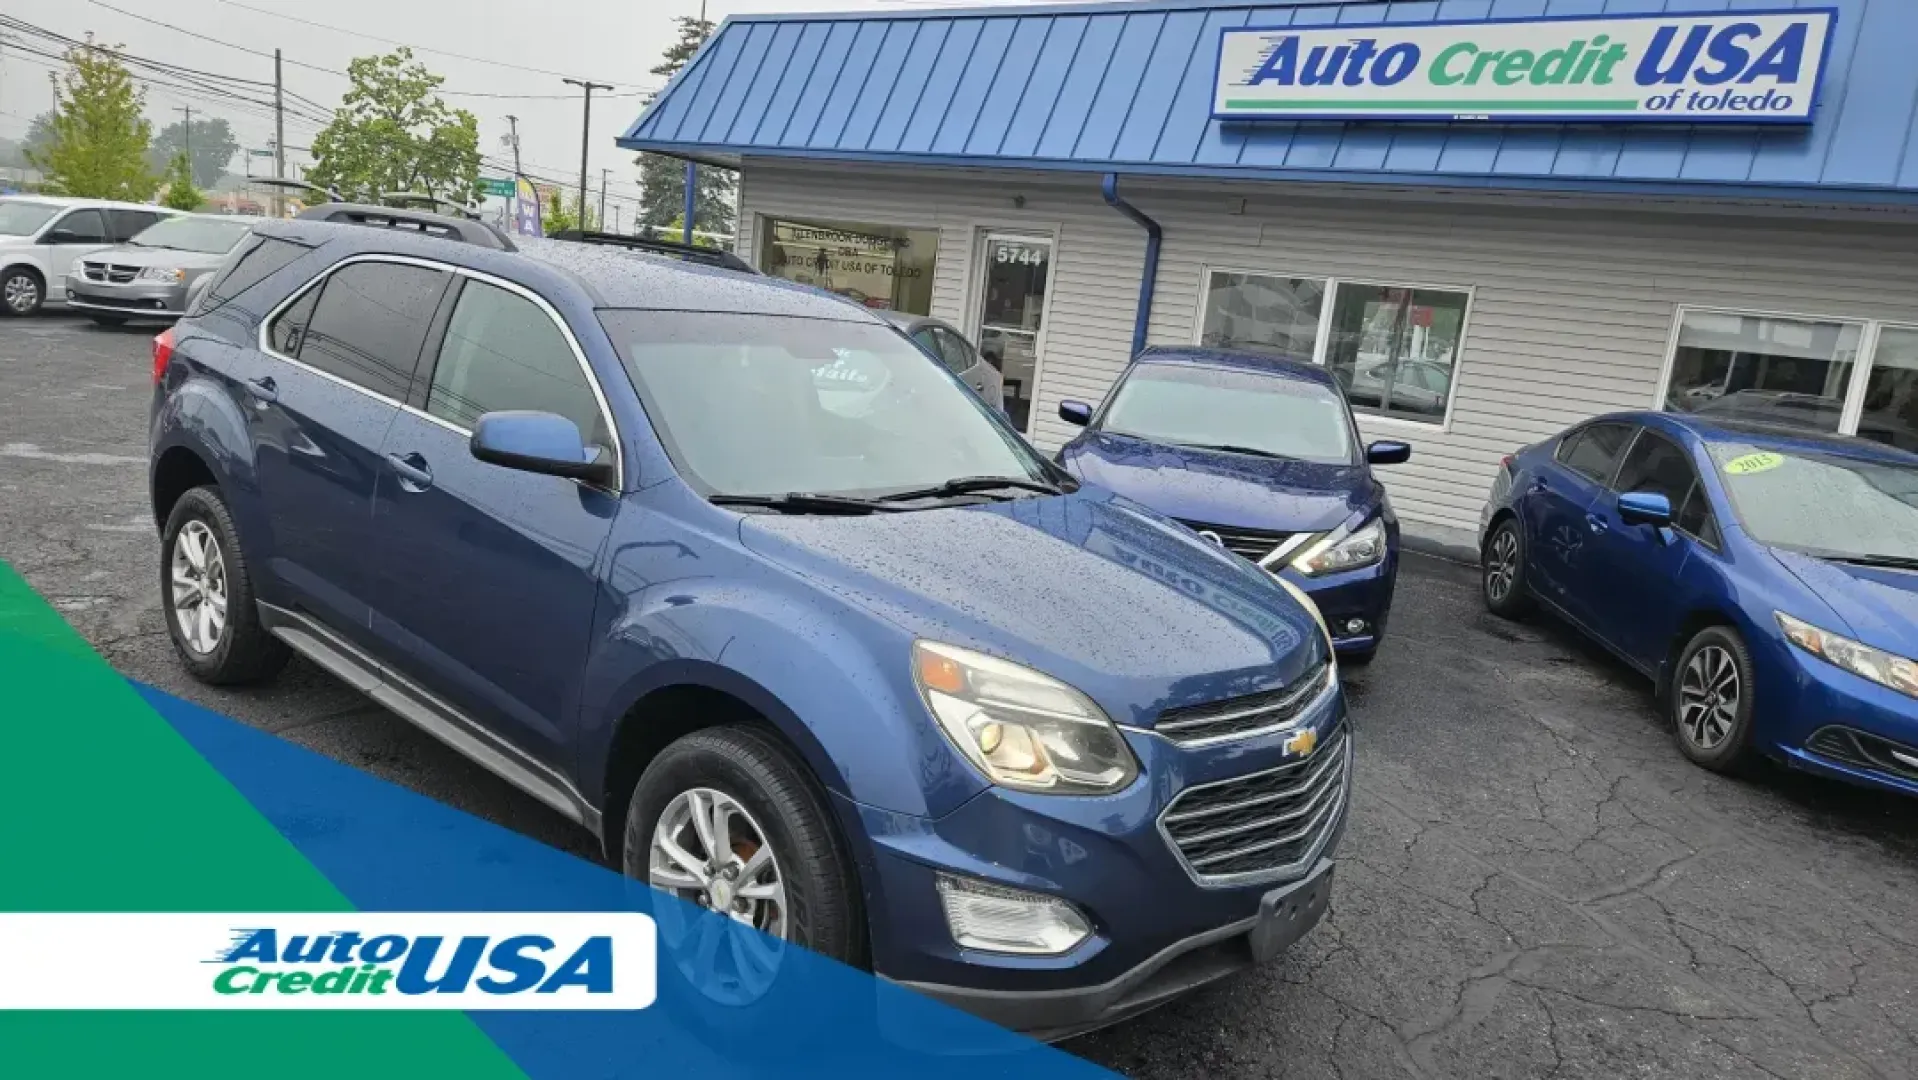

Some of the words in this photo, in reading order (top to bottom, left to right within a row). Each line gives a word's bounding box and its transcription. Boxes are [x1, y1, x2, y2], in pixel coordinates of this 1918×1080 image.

[1243, 36, 1421, 86] Auto
[1428, 34, 1627, 86] Credit
[1634, 22, 1808, 86] USA
[1645, 89, 1683, 111] of
[1687, 89, 1792, 111] toledo
[806, 257, 841, 271] CRDIT
[841, 260, 862, 273] USA
[864, 261, 878, 275] OF
[997, 247, 1041, 267] 5744
